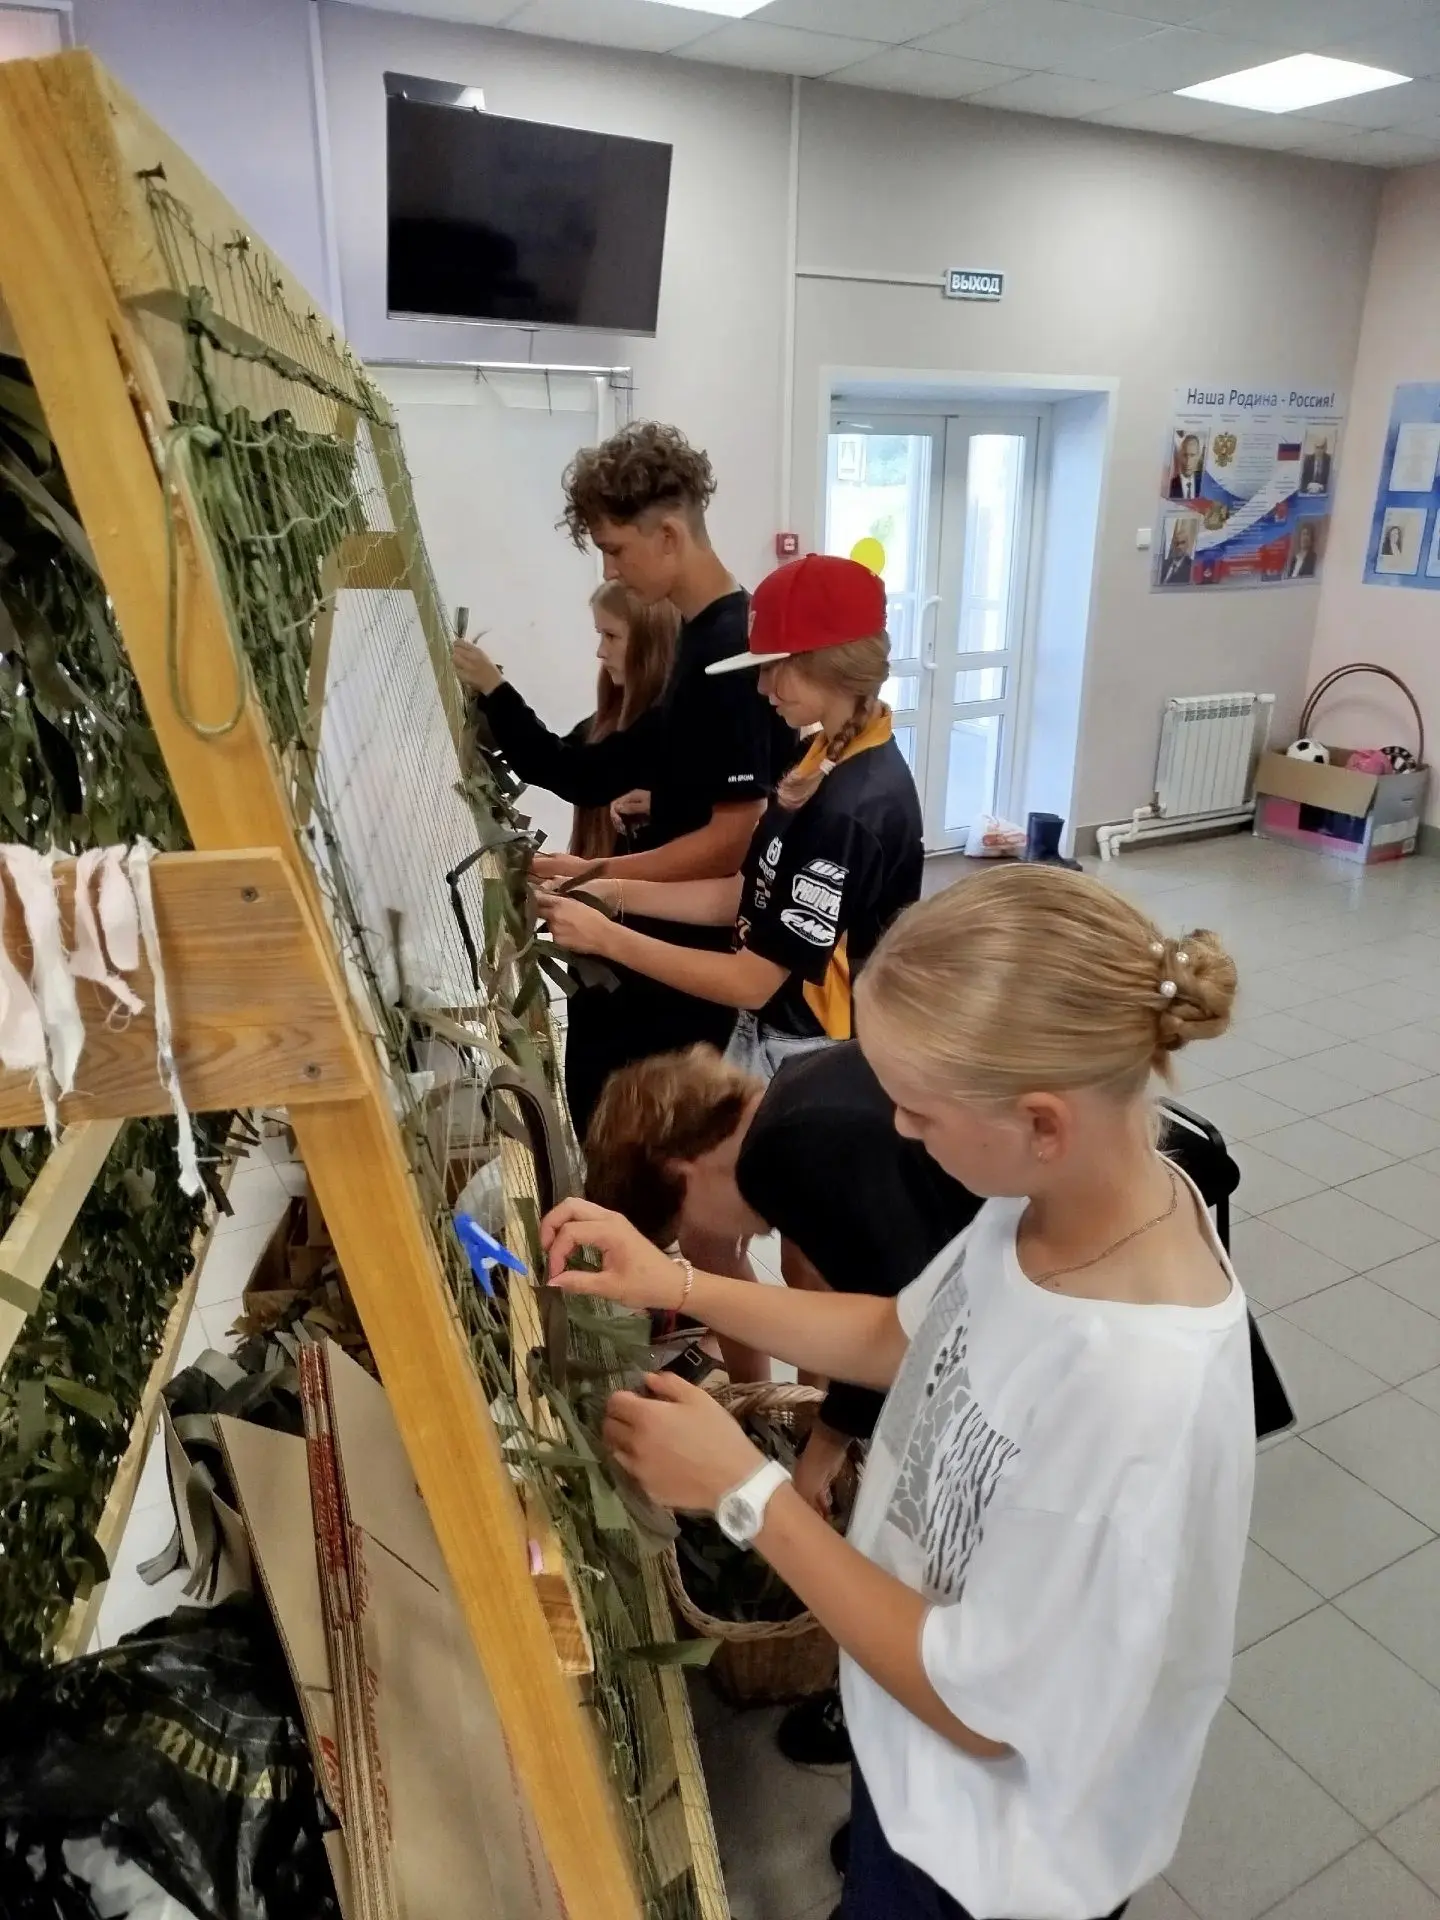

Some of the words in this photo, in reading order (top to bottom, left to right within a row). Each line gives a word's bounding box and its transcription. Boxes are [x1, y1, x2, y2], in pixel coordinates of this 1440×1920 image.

[952, 274, 1000, 293] ВЫХОД
[1187, 388, 1225, 405] Наша
[1229, 389, 1277, 408] Родина
[1289, 391, 1335, 408] Россия!
